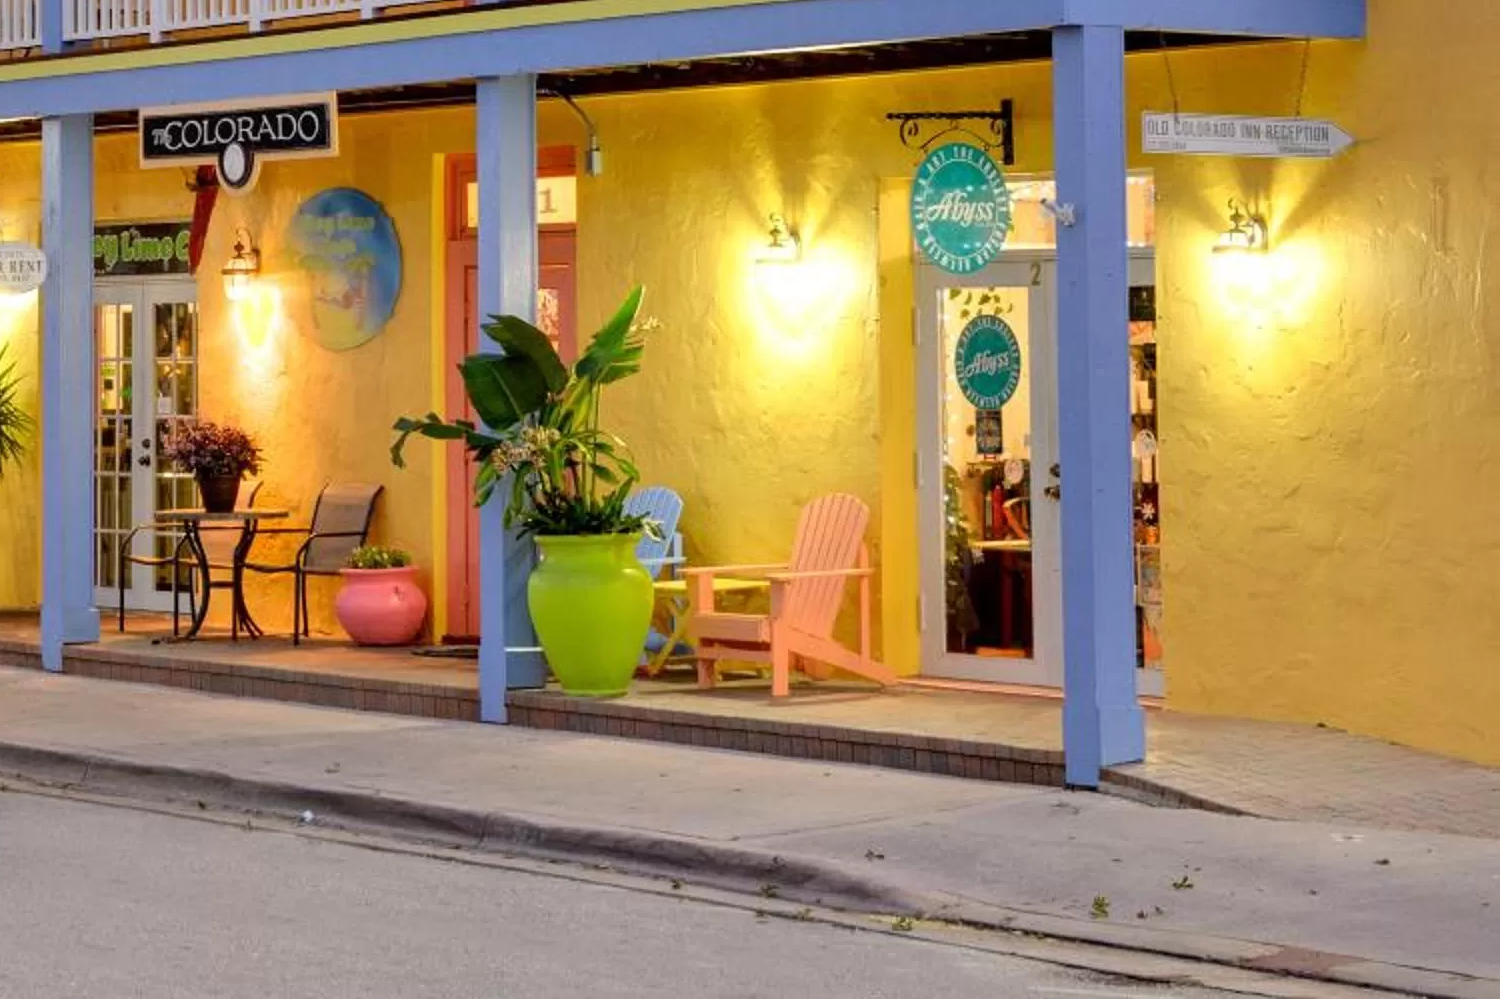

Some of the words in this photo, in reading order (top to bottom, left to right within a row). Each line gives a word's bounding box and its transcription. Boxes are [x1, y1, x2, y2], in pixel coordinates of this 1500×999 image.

[164, 110, 320, 151] COLORADO
[1148, 119, 1169, 136] OLD
[1173, 120, 1236, 138] COLORADO
[1240, 122, 1261, 139] INN
[1265, 124, 1329, 143] RECEPTION
[539, 188, 557, 214] 1
[926, 189, 995, 227] Abyss
[9, 260, 46, 274] RENT
[1030, 262, 1041, 286] 2
[964, 350, 1009, 378] Abyss
